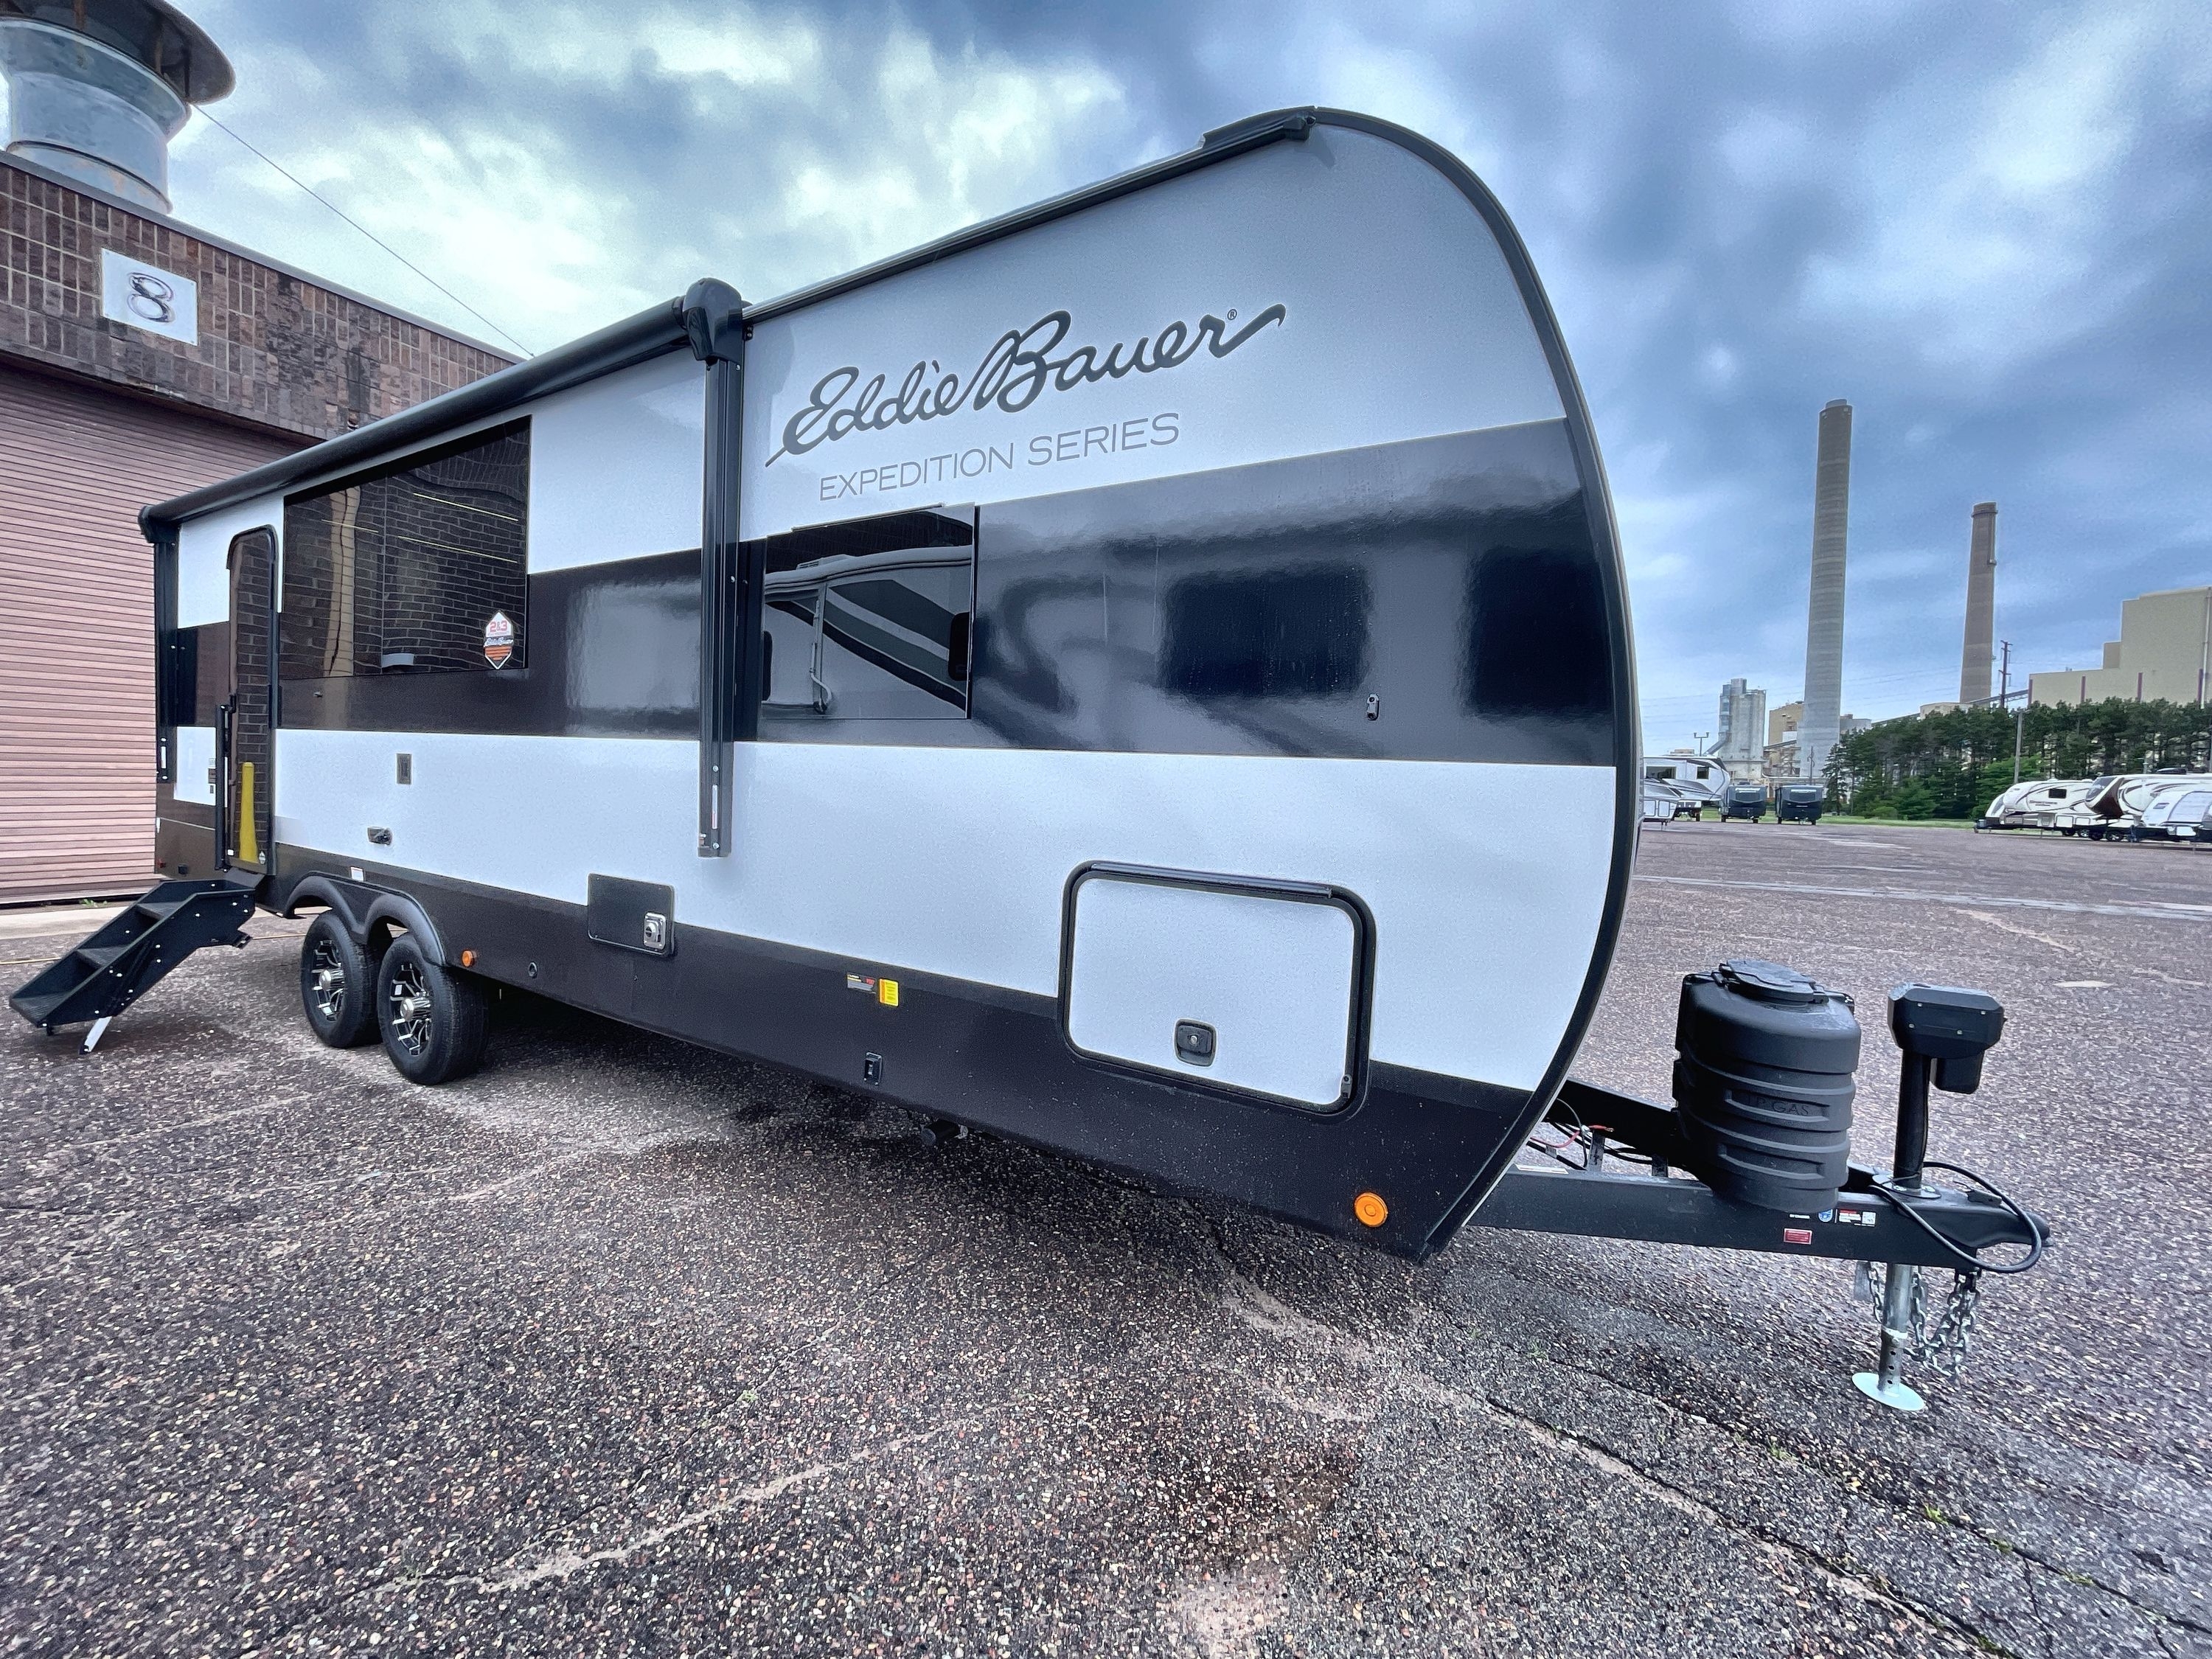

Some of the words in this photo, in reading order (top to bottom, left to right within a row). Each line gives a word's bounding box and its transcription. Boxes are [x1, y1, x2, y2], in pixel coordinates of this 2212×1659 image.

[126, 272, 175, 323] 8
[765, 359, 961, 467] Eddie
[819, 442, 1015, 501] EXPEDITION
[1027, 412, 1180, 466] SERIES
[1772, 1101, 1809, 1116] GAS
